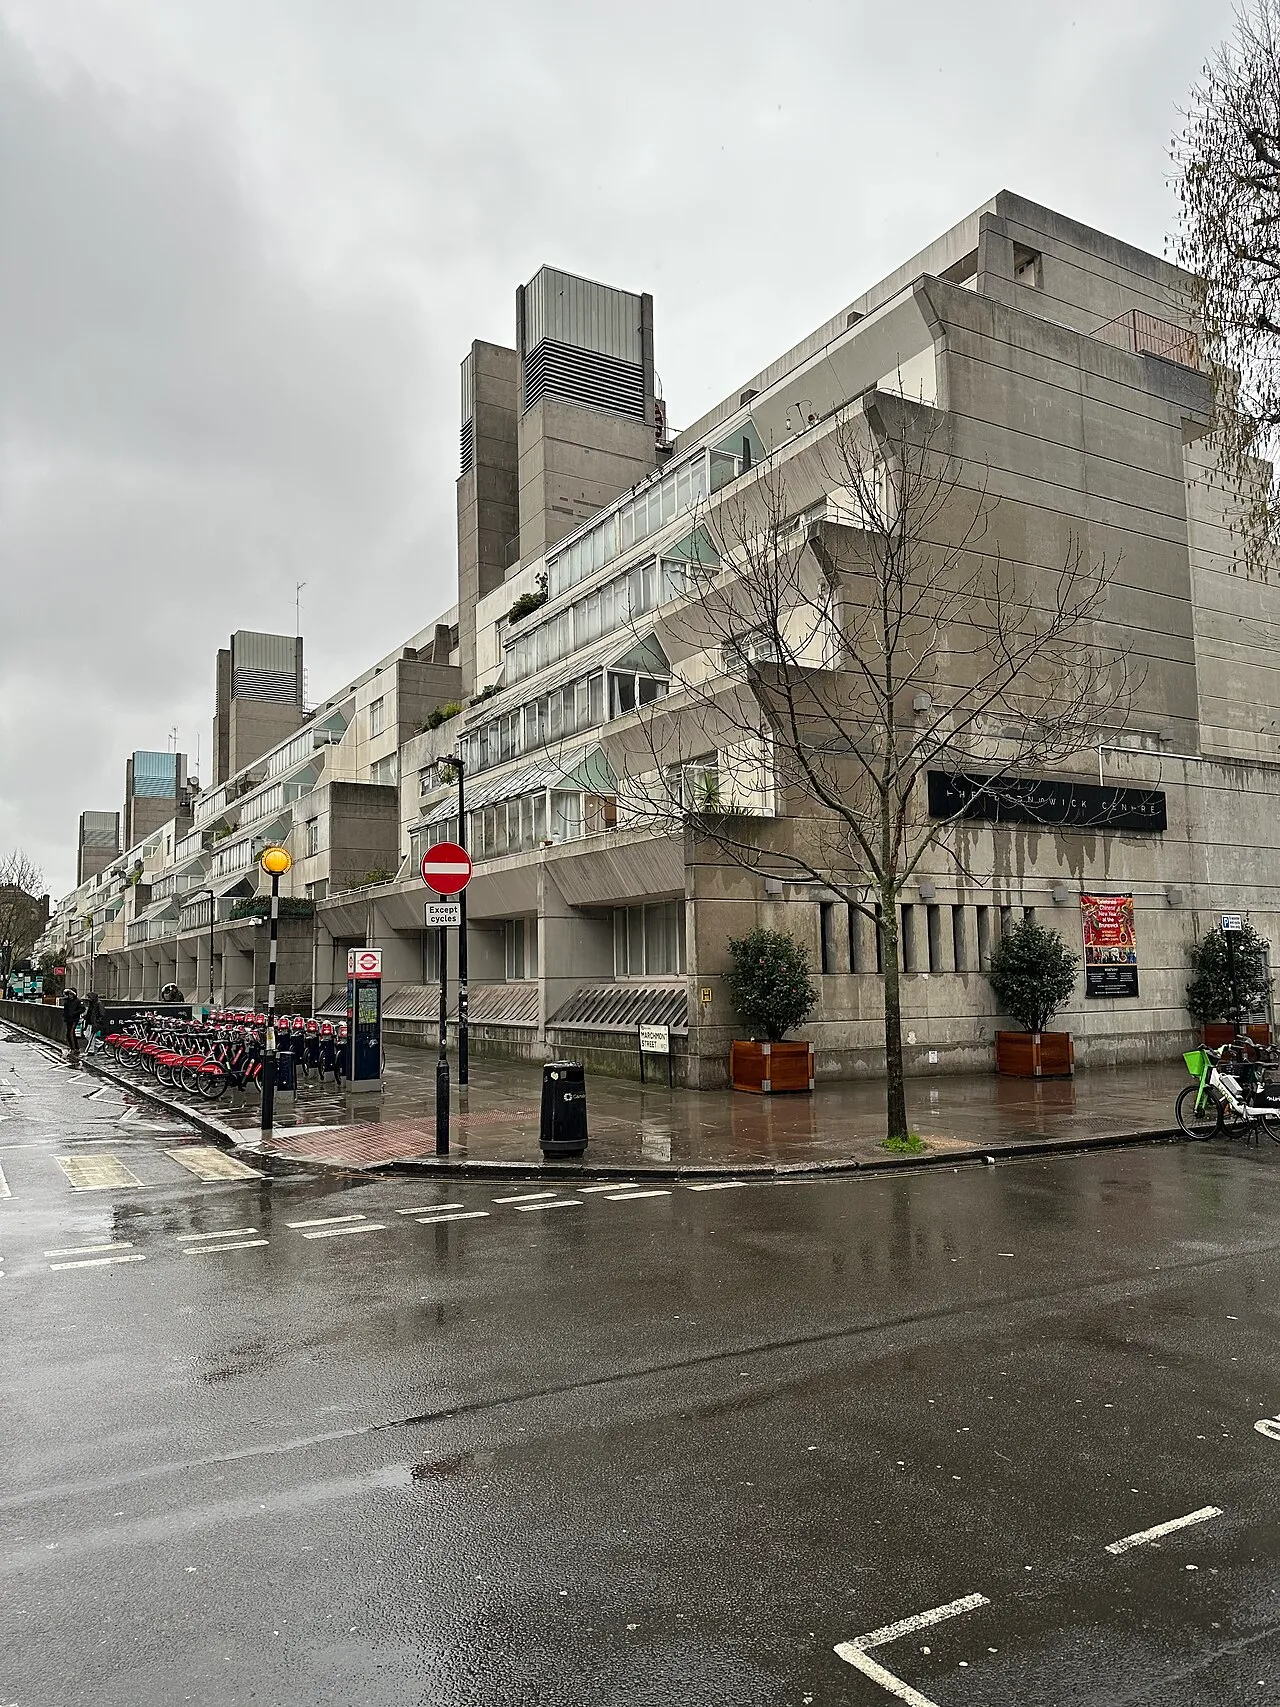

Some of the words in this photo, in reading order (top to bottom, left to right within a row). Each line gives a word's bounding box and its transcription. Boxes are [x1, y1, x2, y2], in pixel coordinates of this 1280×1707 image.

[429, 906, 458, 914] Except
[430, 915, 457, 924] cycles
[641, 1040, 657, 1049] STREET
